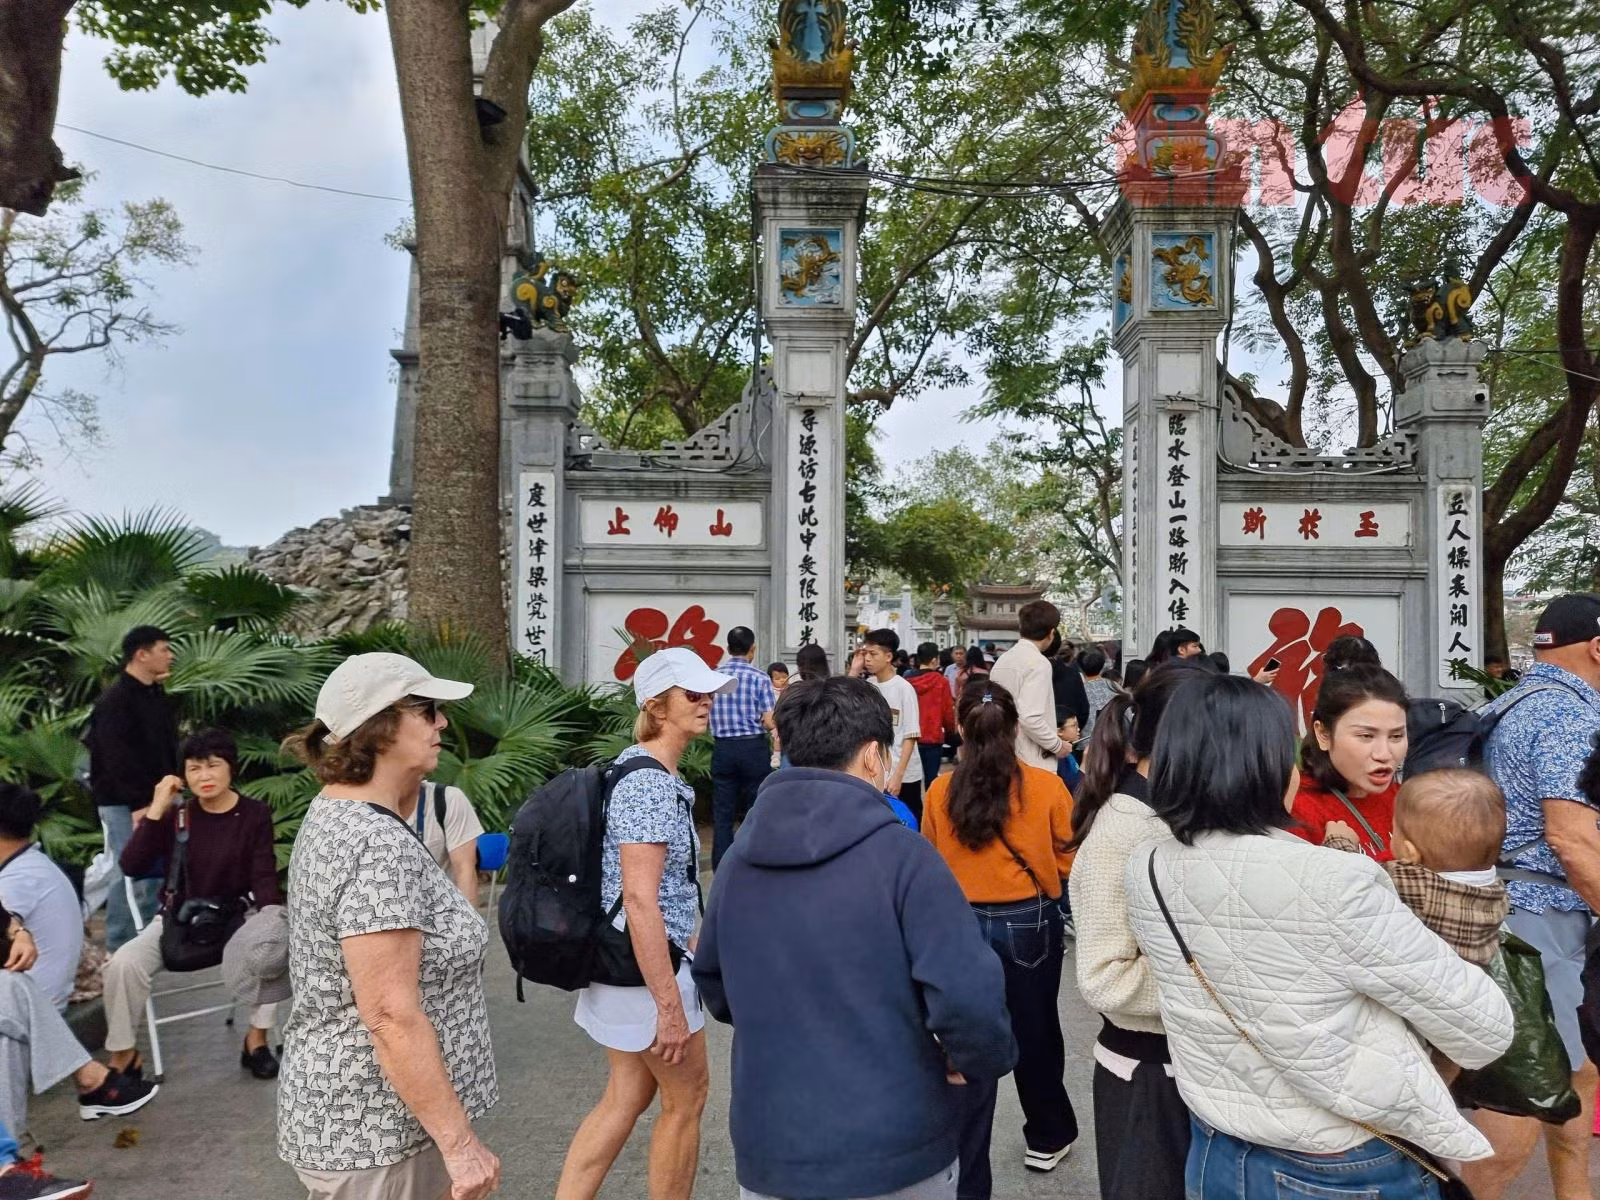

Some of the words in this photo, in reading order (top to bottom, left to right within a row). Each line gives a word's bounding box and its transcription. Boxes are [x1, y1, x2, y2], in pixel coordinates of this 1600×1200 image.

[1167, 413, 1190, 632] 臨水登山一路漸入佳
